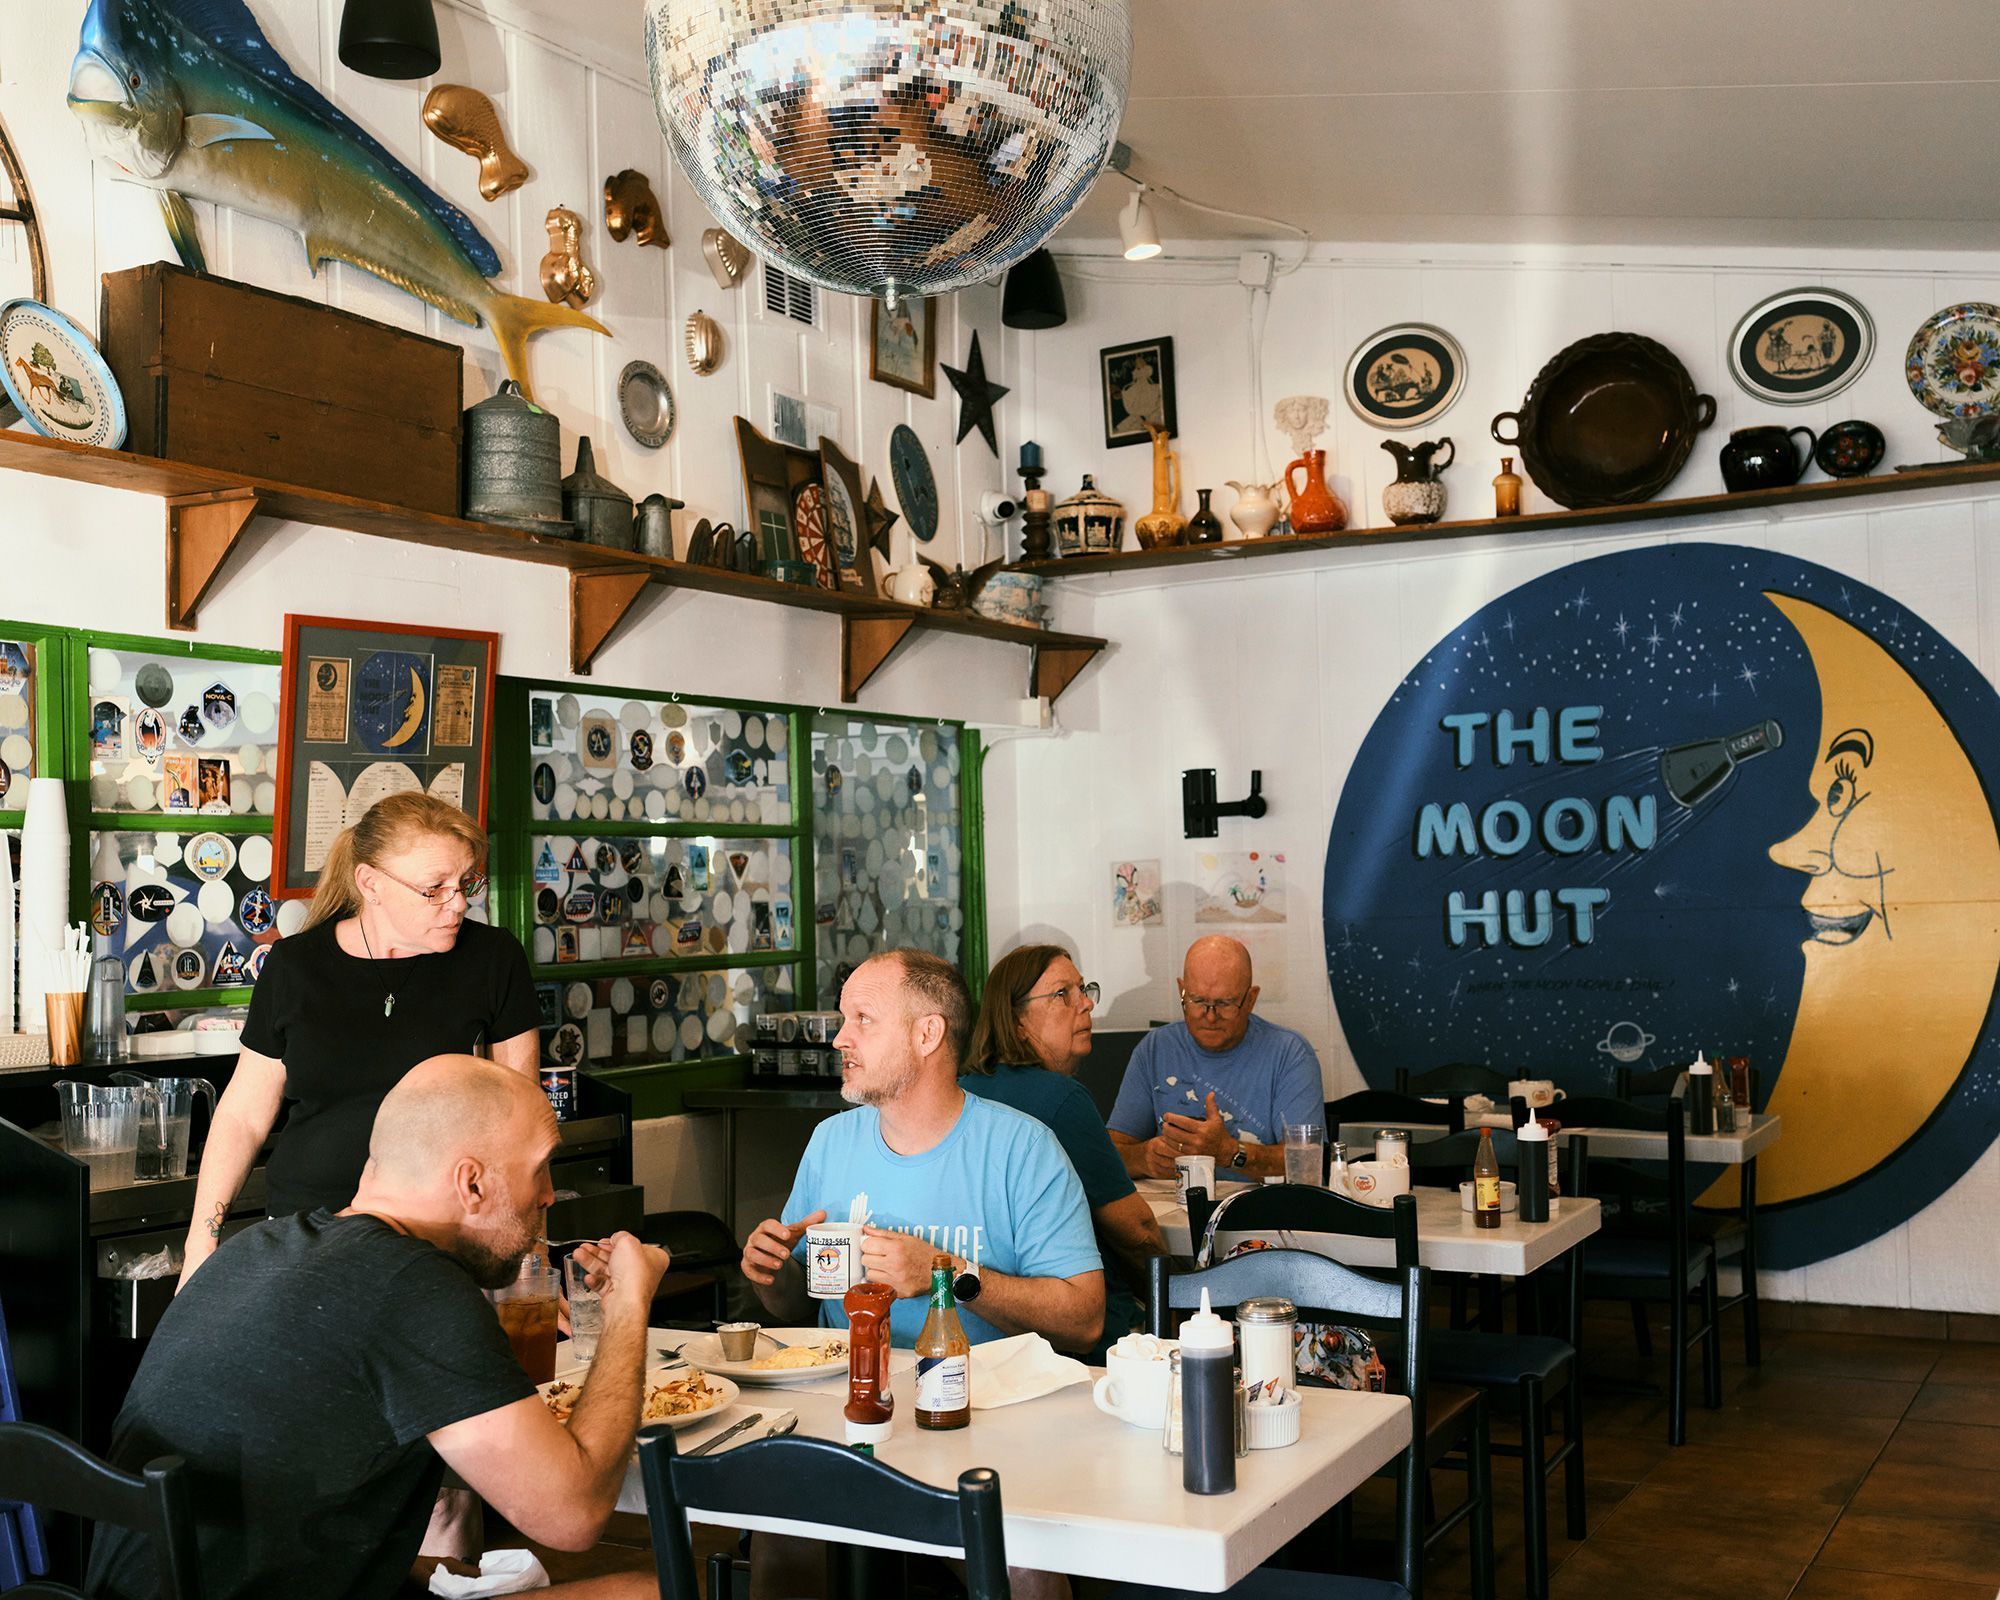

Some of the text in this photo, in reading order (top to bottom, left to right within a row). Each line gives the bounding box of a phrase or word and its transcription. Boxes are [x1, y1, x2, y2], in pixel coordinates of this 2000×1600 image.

[205, 693, 233, 701] NOVA-C
[1441, 706, 1603, 769] THE
[1731, 734, 1756, 753] USA
[1413, 794, 1657, 860] MOON
[1446, 887, 1610, 948] HUT
[887, 1225, 984, 1266] TICE
